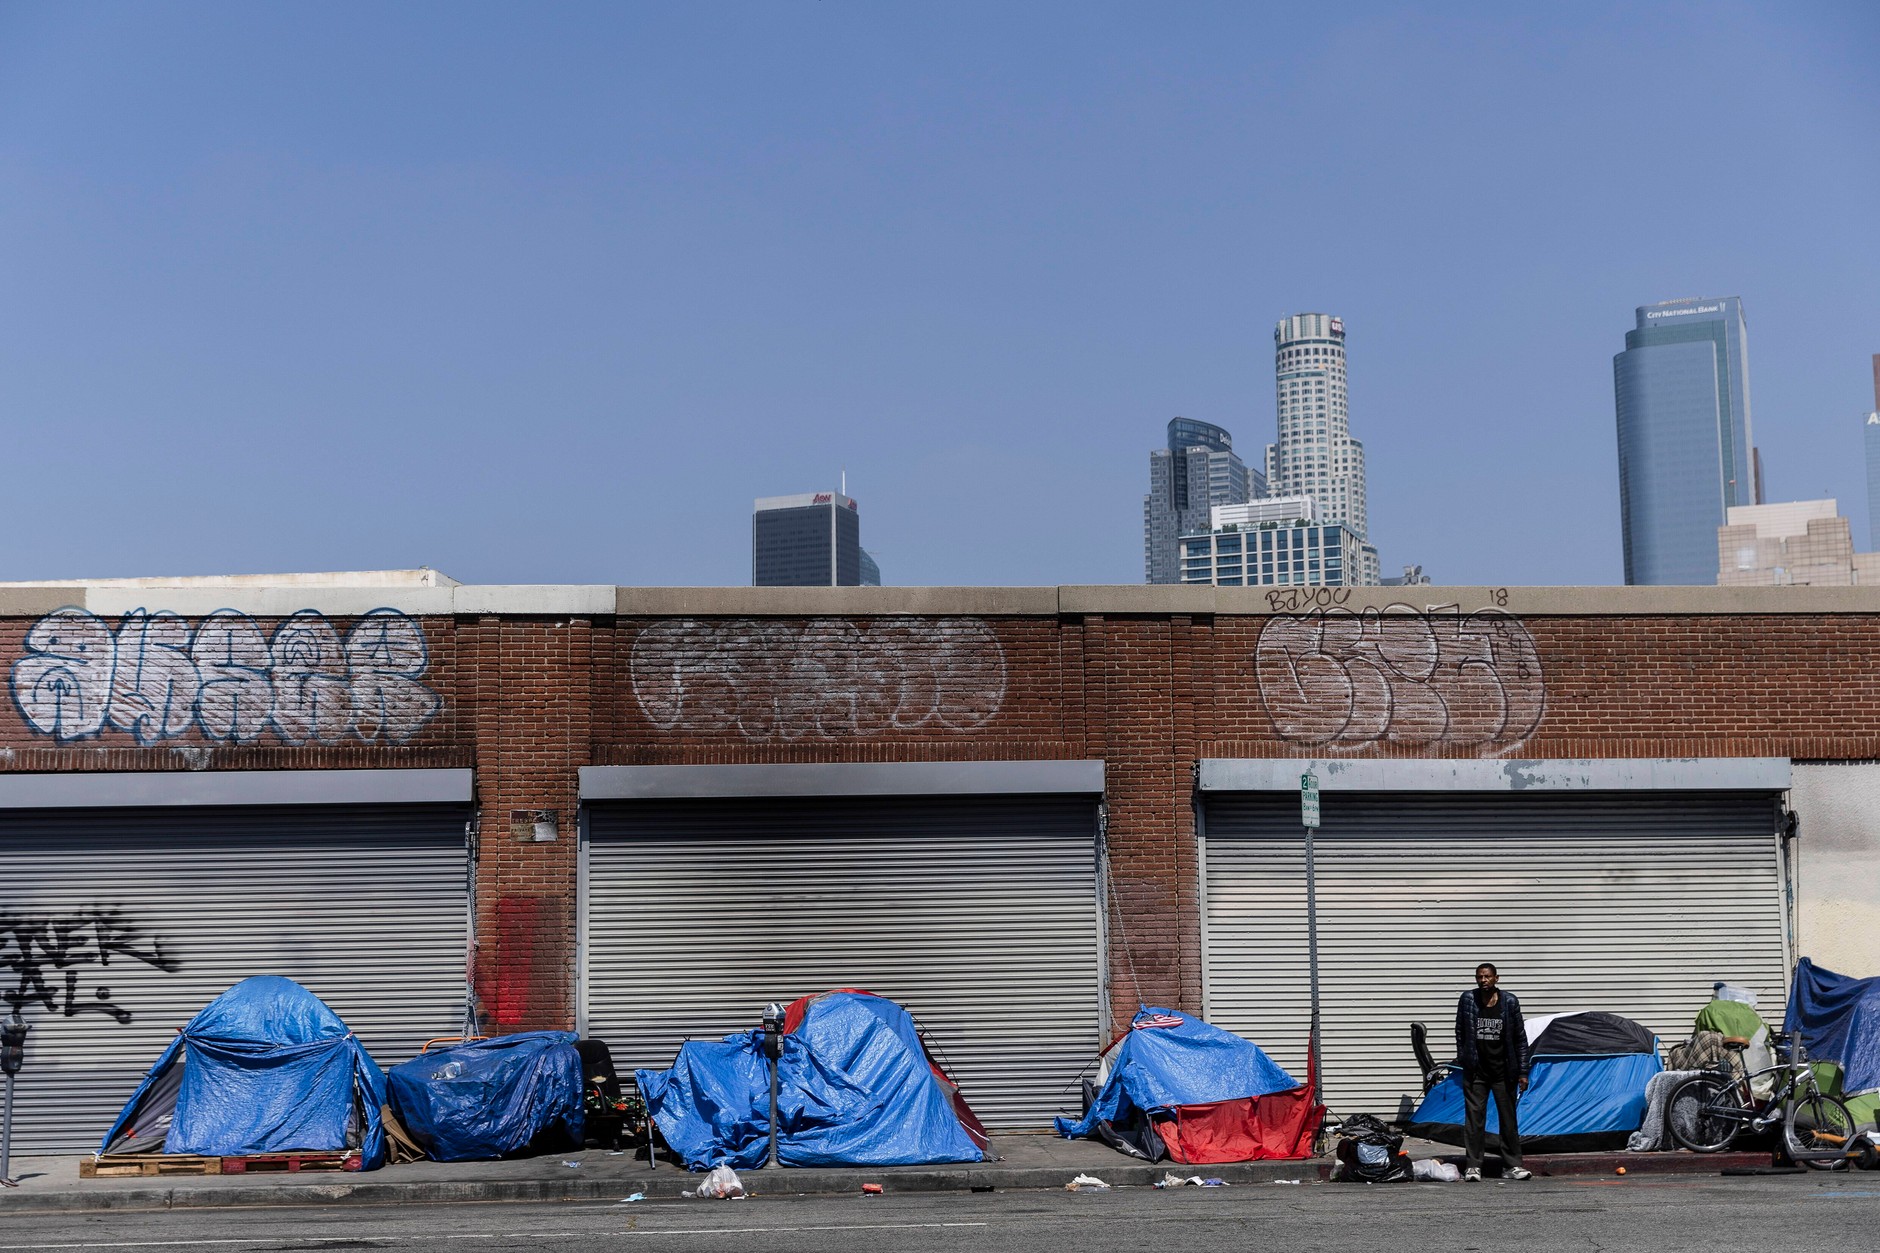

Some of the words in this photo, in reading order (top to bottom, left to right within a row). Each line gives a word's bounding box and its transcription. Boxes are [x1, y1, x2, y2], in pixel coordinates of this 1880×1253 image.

[1489, 588, 1508, 606] 18
[1302, 776, 1308, 789] 2
[1302, 791, 1318, 802] PARKING
